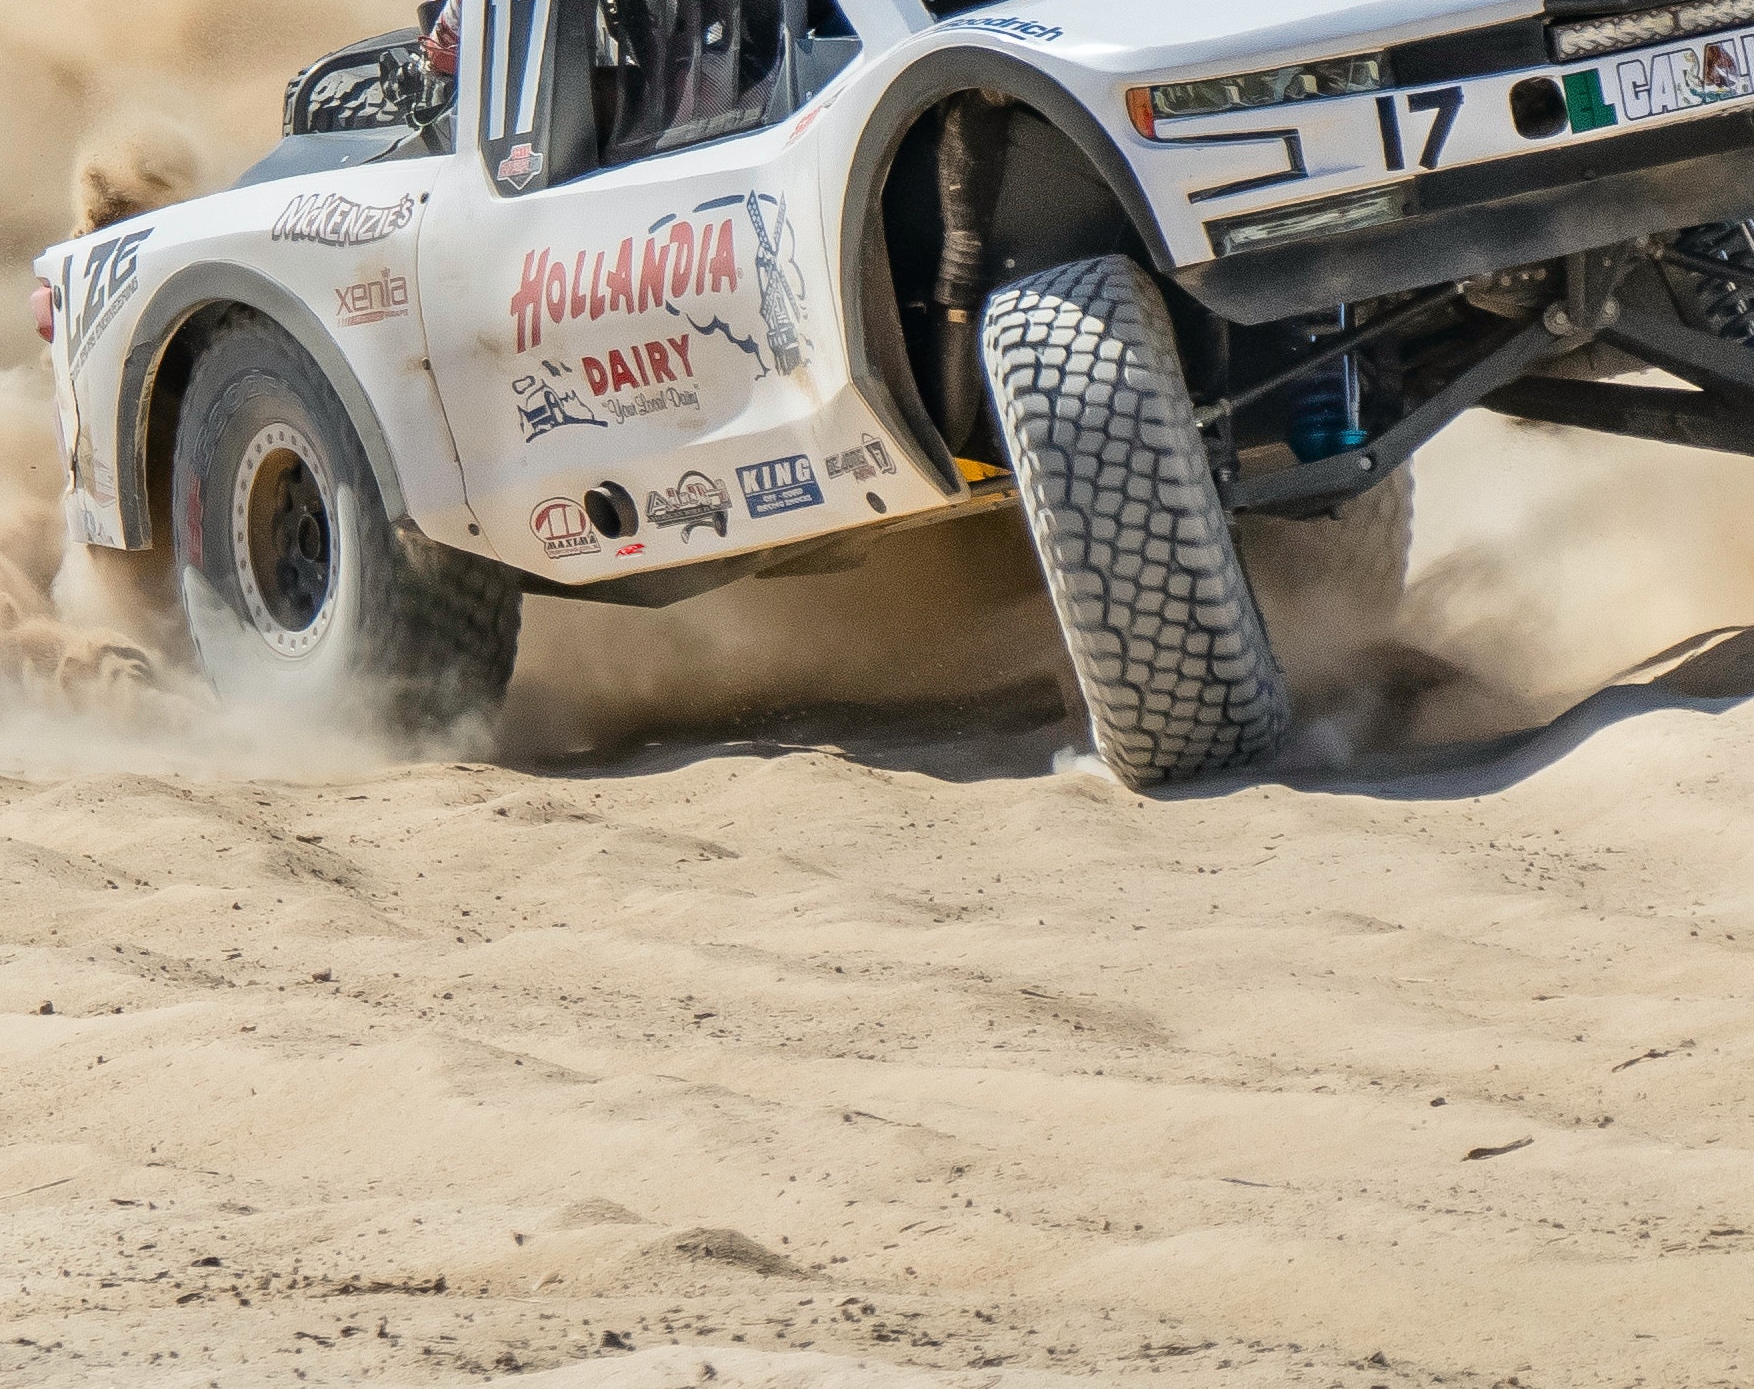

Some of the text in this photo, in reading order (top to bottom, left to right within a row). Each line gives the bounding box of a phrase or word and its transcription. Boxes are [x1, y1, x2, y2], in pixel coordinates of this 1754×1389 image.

[1375, 86, 1466, 172] 17
[1561, 67, 1619, 134] EL
[334, 266, 409, 316] xenia
[510, 217, 738, 354] HOLLANDIA
[581, 333, 695, 397] DAIRY
[743, 458, 811, 494] KING
[546, 534, 598, 550] MAXIMA
